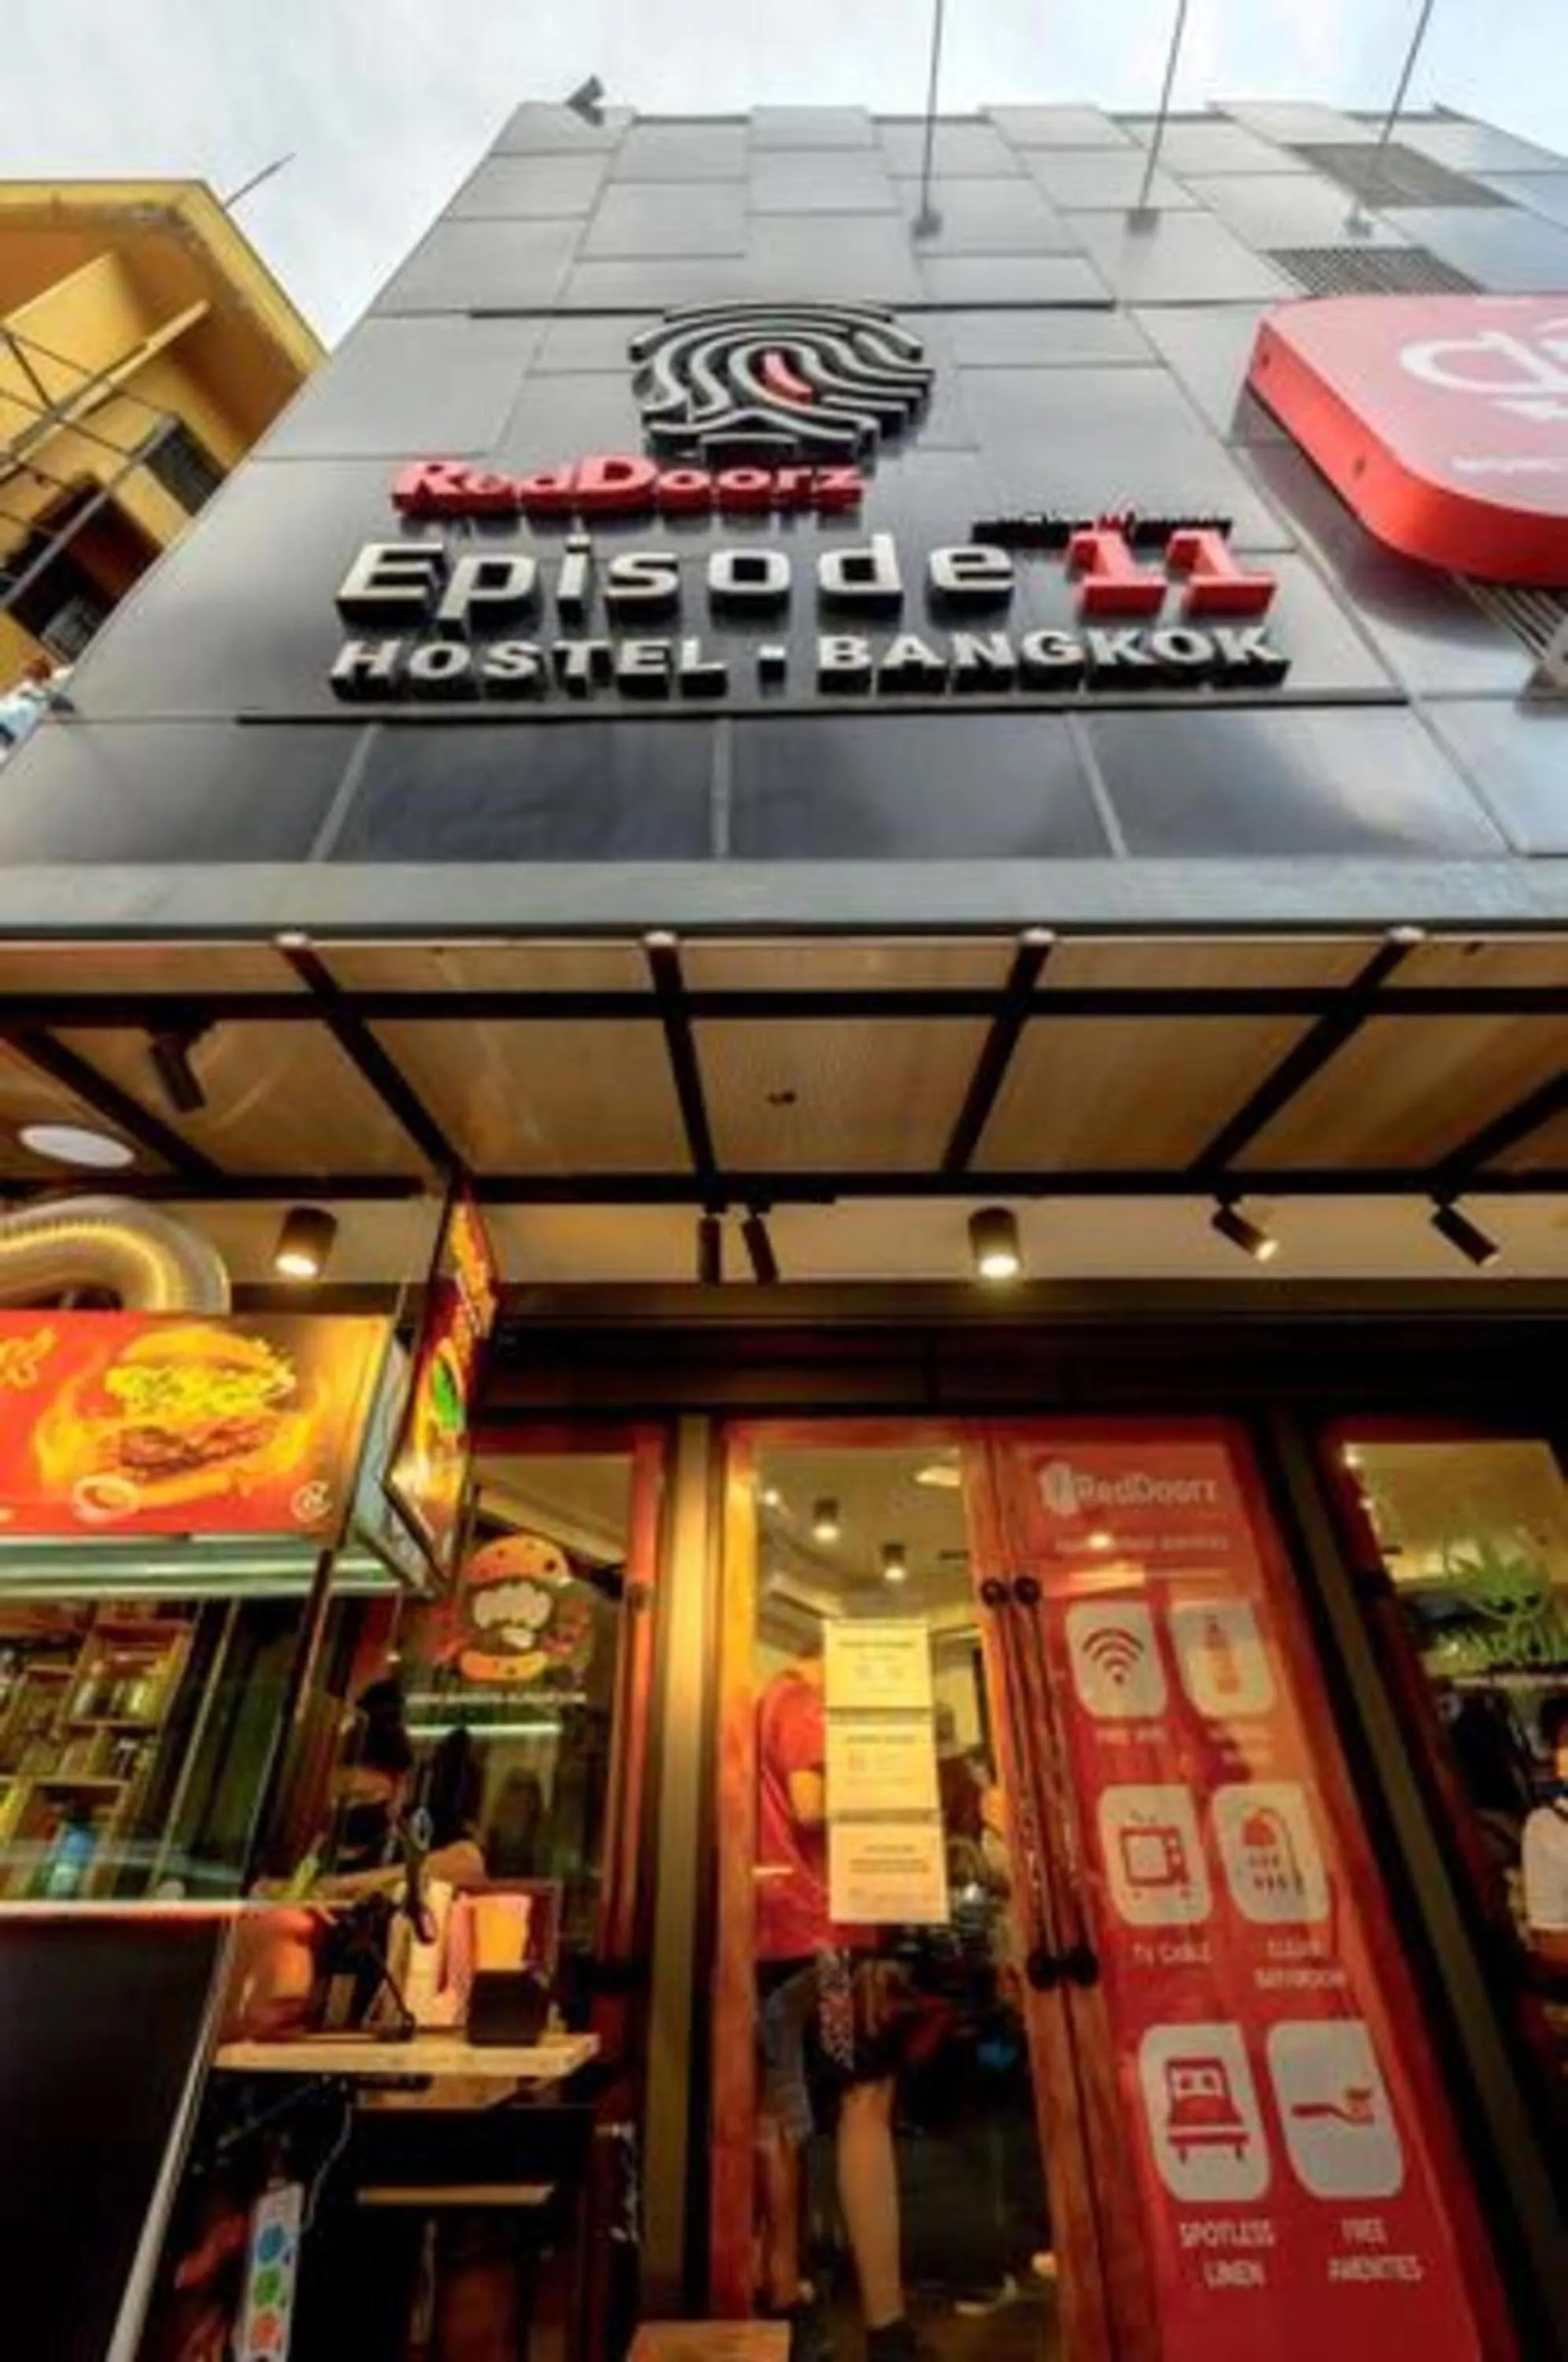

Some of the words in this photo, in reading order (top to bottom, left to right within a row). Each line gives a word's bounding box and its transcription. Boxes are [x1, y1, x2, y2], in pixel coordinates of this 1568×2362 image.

[392, 456, 864, 513] RedDoorz
[337, 534, 1015, 630] Episode
[1066, 528, 1277, 614] 11
[331, 639, 729, 696] HOSTEL
[816, 628, 1292, 690] BANGKOK
